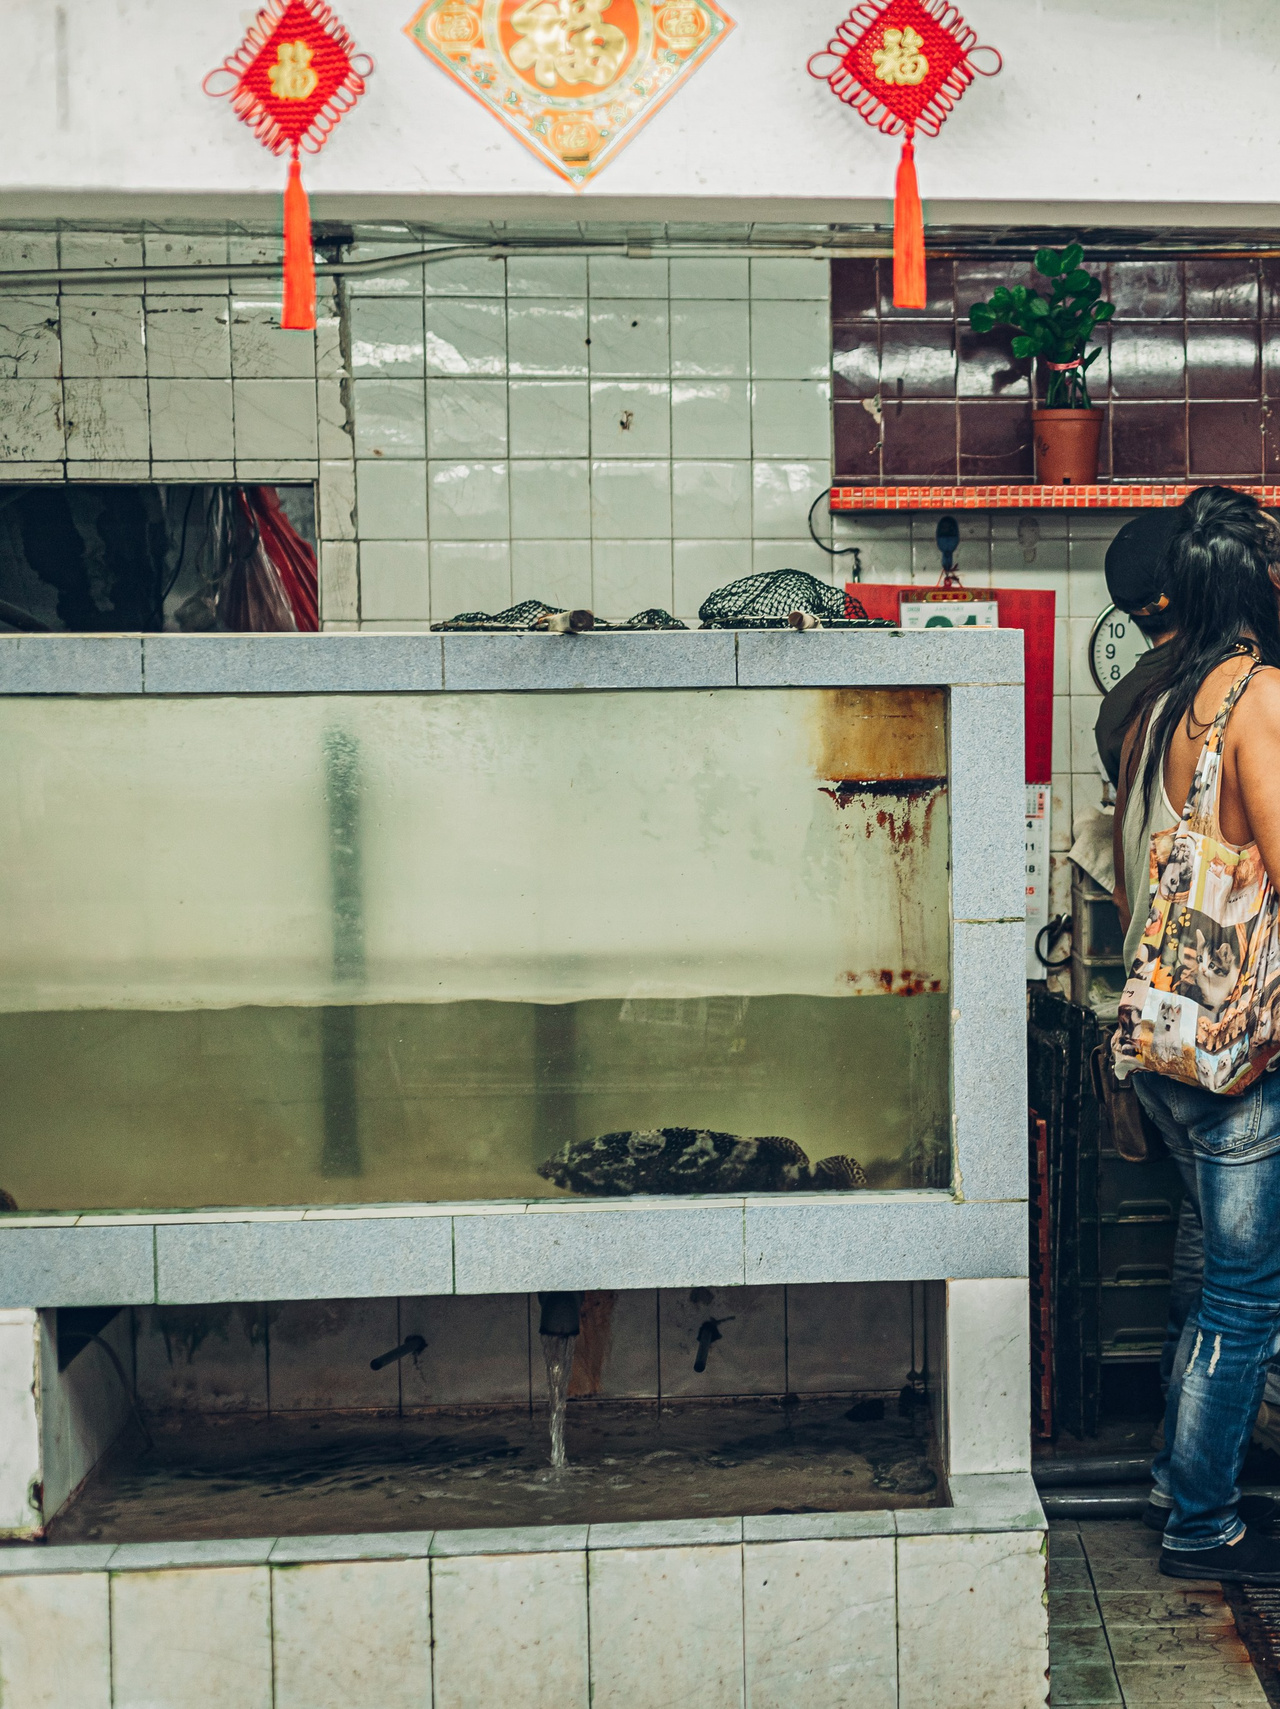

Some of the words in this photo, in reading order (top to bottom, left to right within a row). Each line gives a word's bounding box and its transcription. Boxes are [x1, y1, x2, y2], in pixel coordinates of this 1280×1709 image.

[872, 26, 929, 86] 福
[268, 40, 318, 100] 福
[1108, 623, 1125, 639] 10
[1105, 643, 1116, 660] 9
[1110, 664, 1121, 680] 8
[1026, 820, 1033, 829] 4
